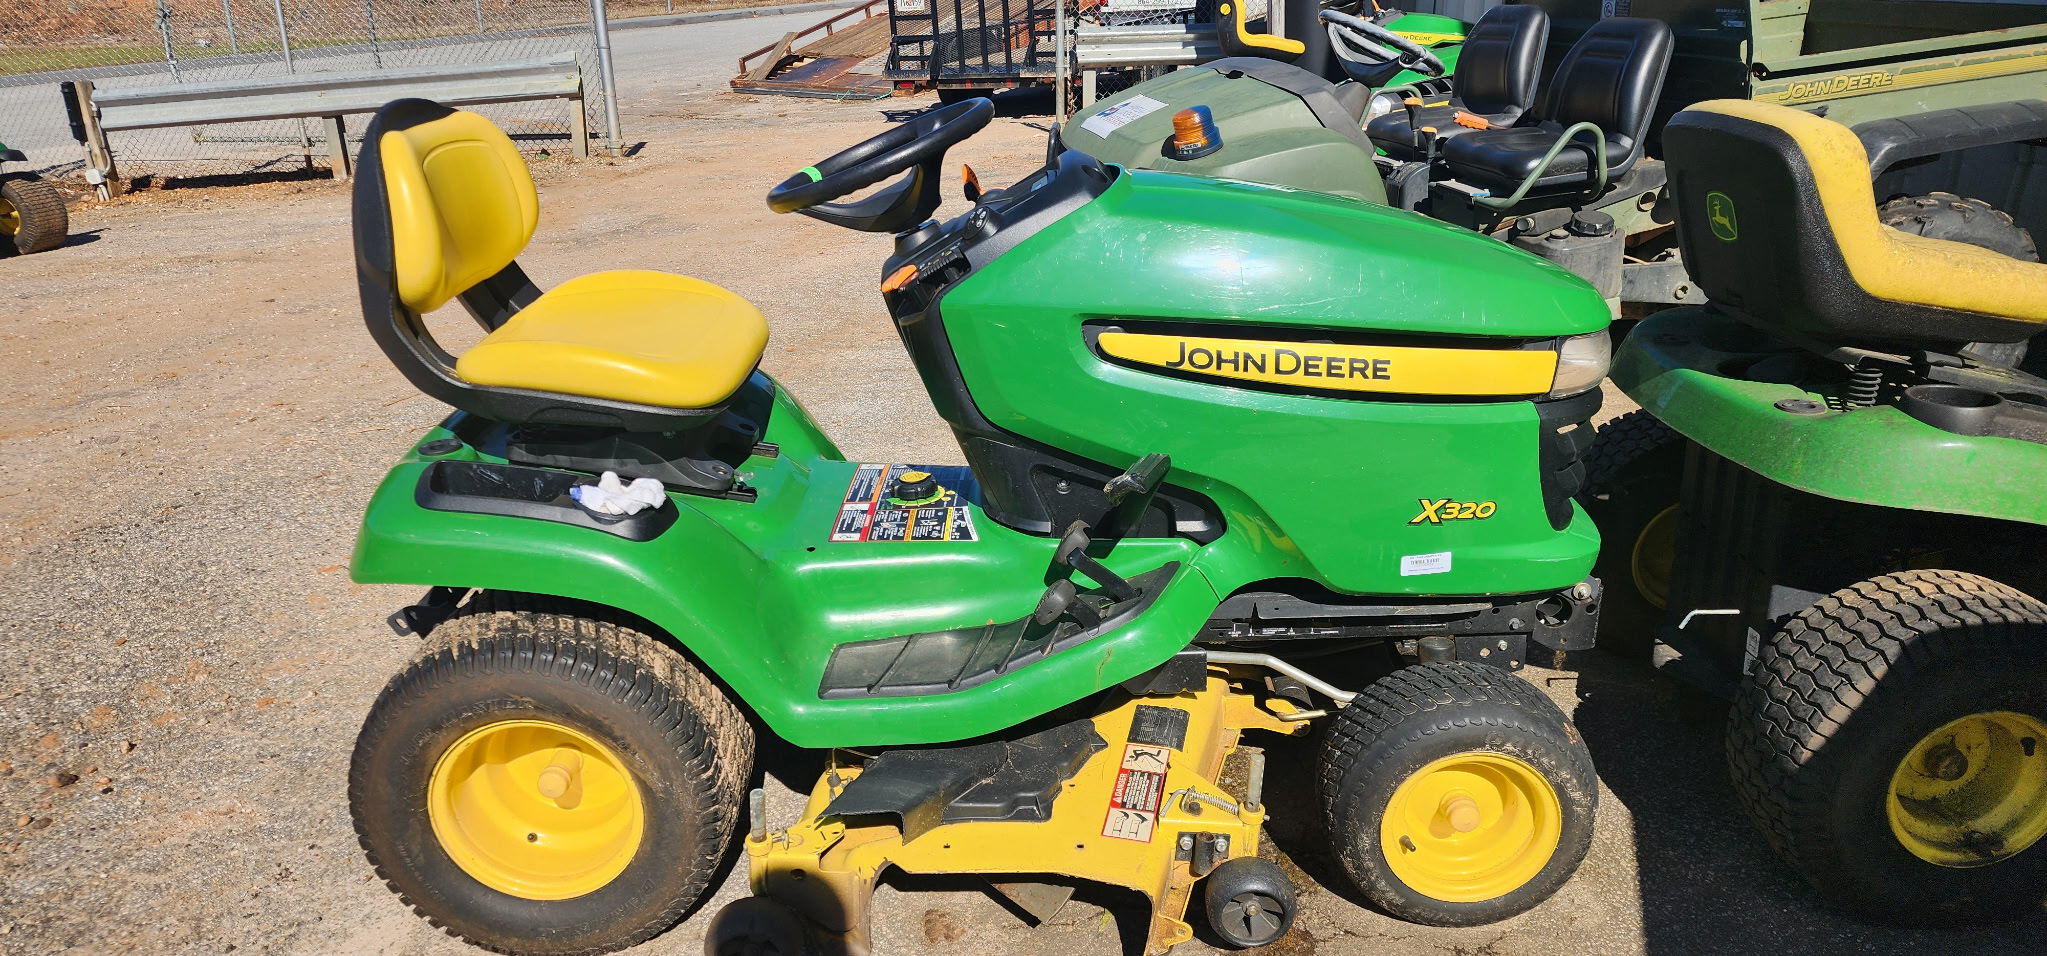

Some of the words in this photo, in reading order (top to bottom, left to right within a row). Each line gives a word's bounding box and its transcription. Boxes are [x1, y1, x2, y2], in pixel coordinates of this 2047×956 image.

[1779, 80, 1832, 100] JOHN
[1831, 72, 1893, 93] DEERE
[1166, 342, 1266, 374] JOHN
[1275, 349, 1391, 380] DEERE
[1407, 498, 1497, 525] X320
